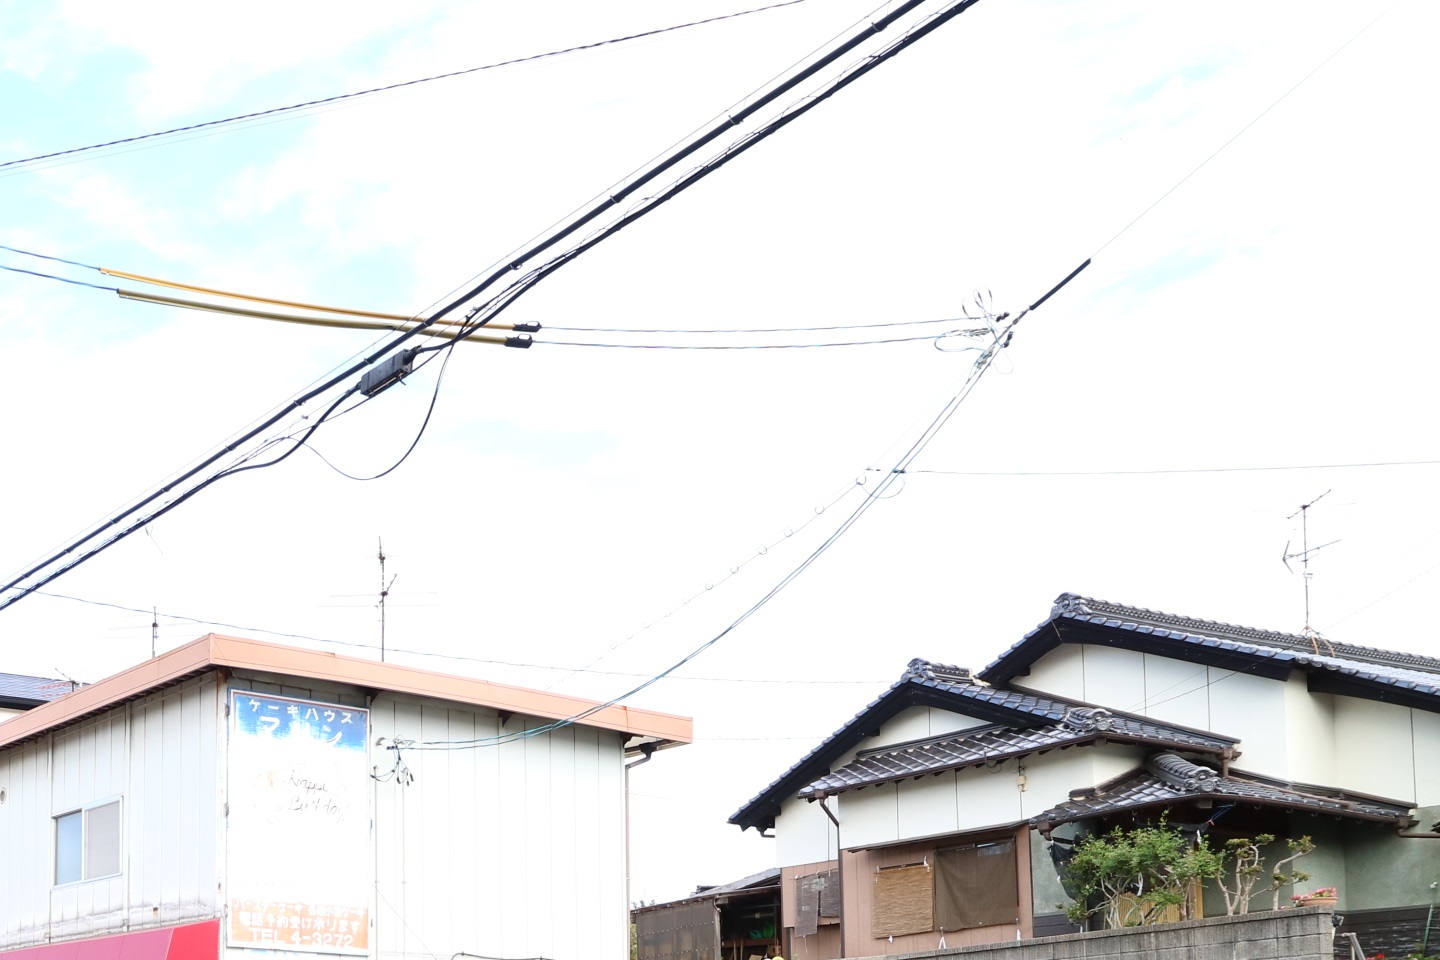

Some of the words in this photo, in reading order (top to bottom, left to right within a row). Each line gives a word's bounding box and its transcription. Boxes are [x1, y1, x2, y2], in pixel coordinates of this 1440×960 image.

[249, 699, 353, 724] ケーキハウス
[239, 911, 361, 934] 電話予約受け承ります
[248, 927, 286, 944] TEL
[290, 930, 354, 948] 4-3272
